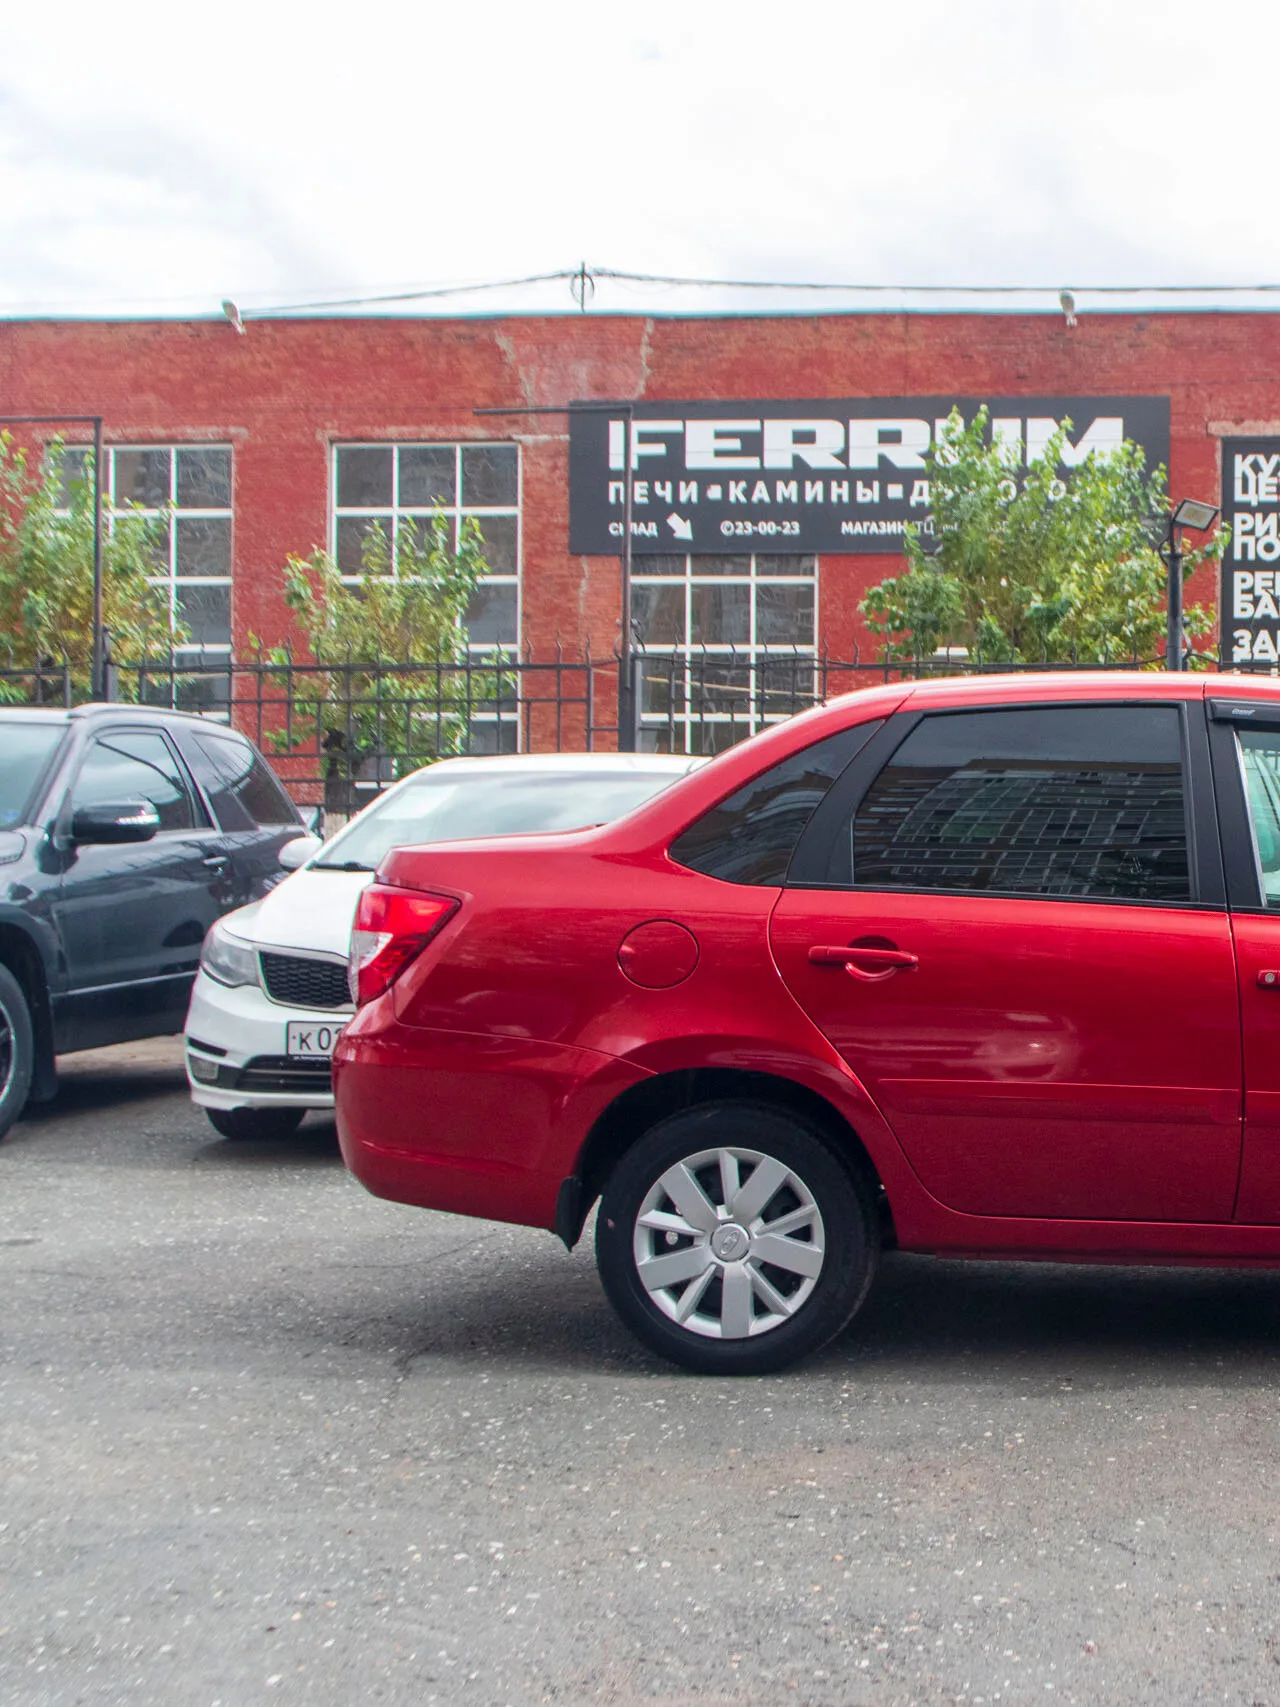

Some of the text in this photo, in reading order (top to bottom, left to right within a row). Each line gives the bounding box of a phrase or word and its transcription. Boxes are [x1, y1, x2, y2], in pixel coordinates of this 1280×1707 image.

[608, 416, 1124, 470] FERRUM
[608, 480, 880, 504] ПЕЧИ КАМИНЫ
[734, 520, 801, 536] 23-00-23
